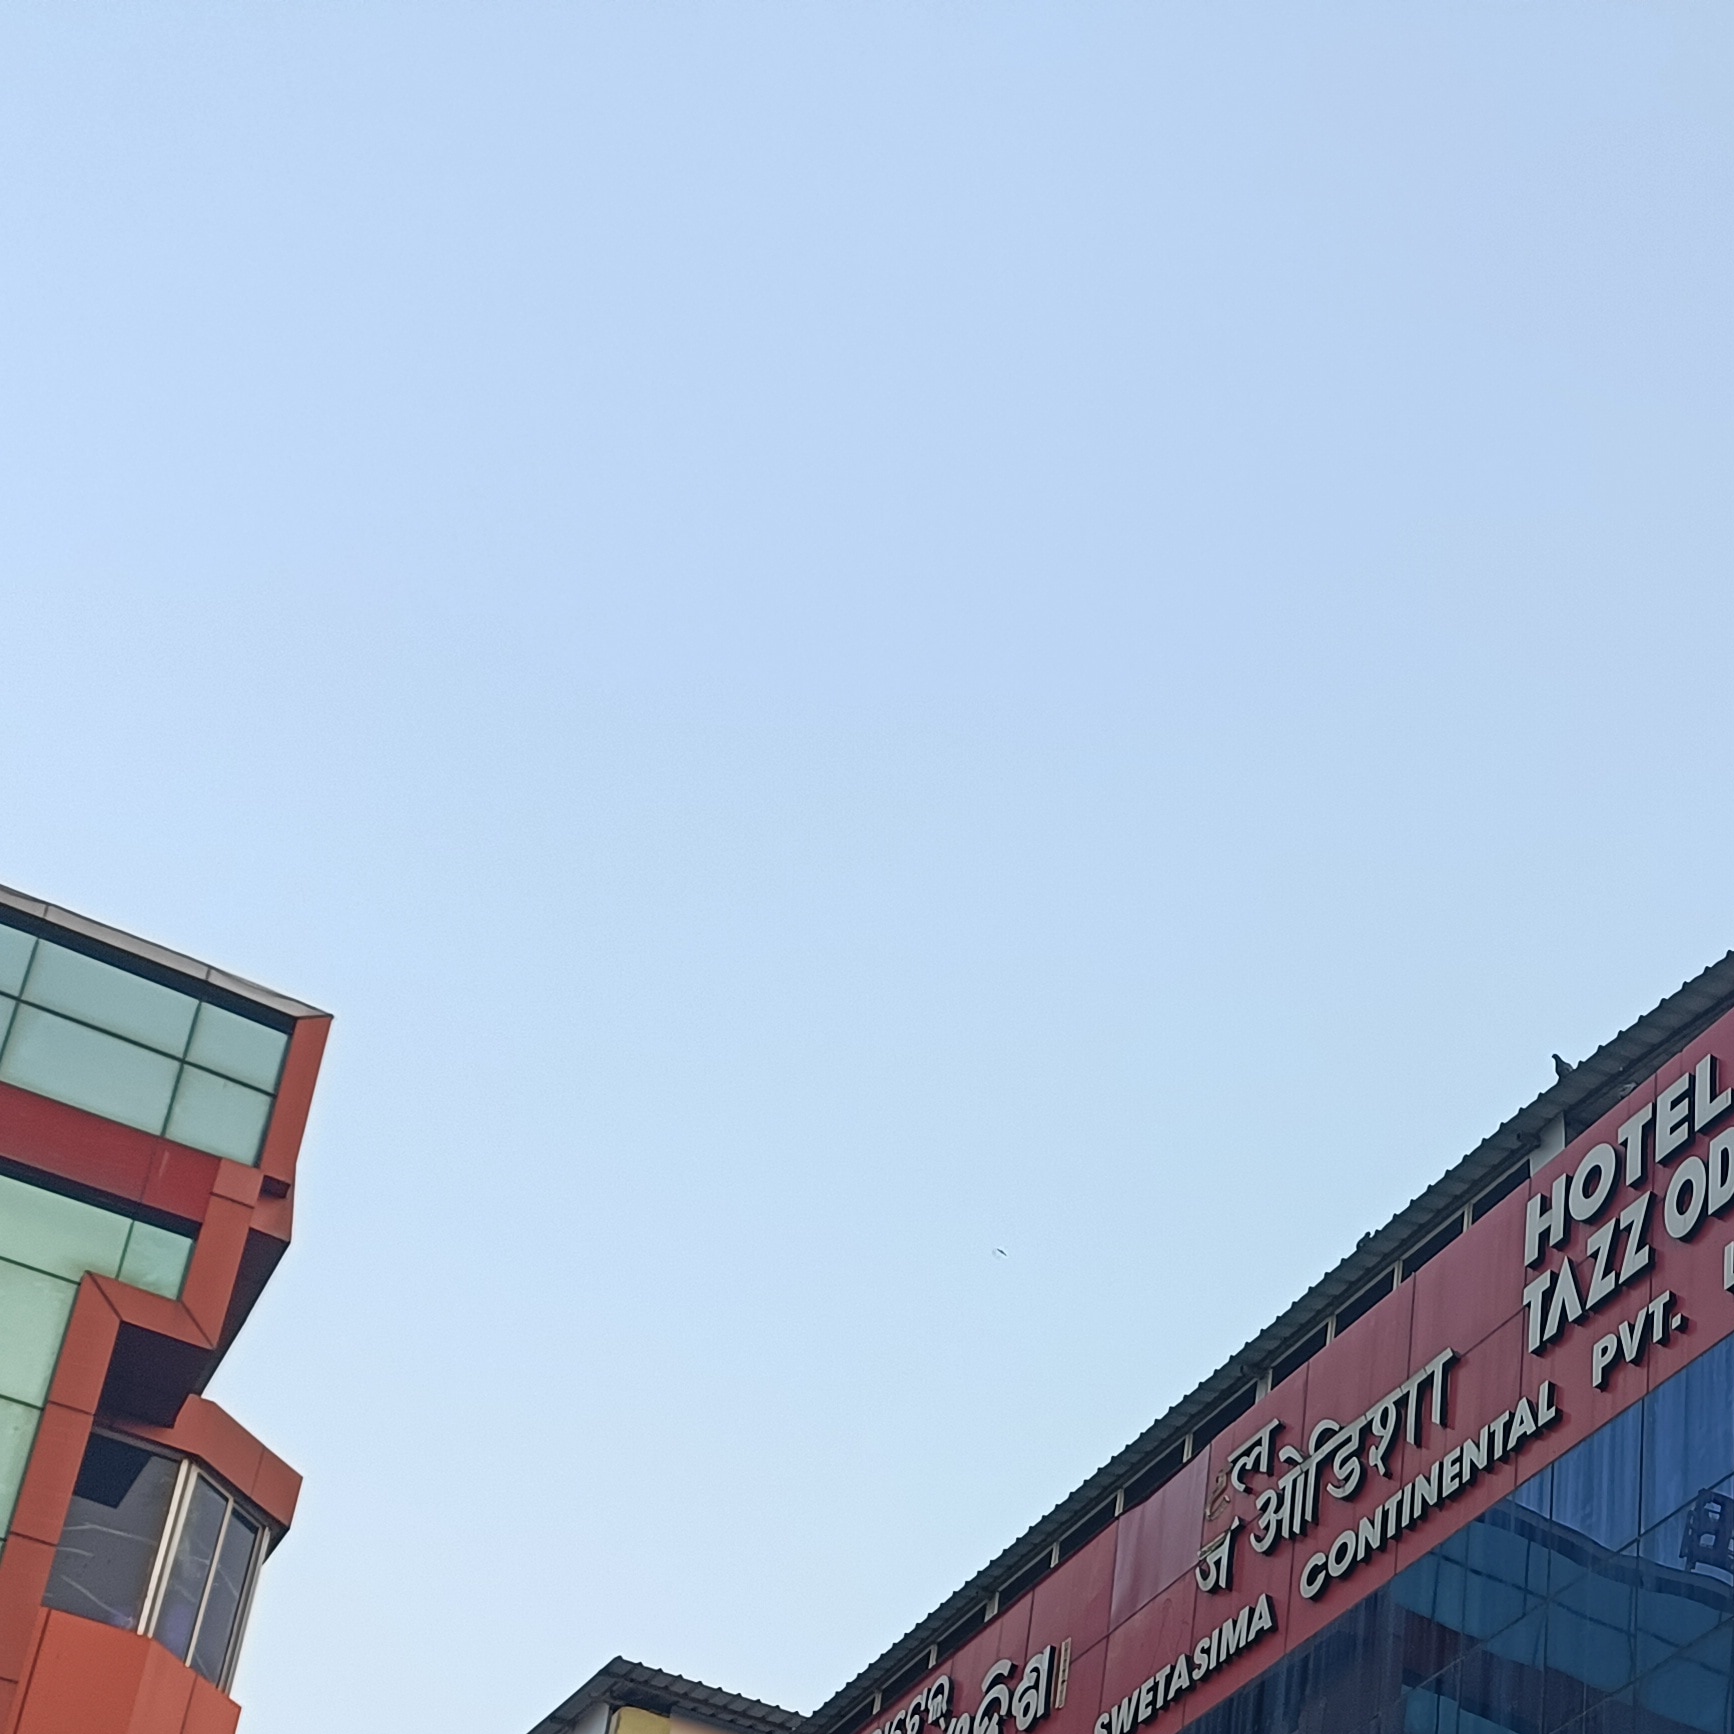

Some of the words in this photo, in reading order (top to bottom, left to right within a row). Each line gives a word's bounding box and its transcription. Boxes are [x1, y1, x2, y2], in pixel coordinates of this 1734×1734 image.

[1524, 1053, 1732, 1267] HOTEL
[1523, 1191, 1655, 1354] TAZZ
[1300, 1380, 1557, 1598] CONTINENTAL
[1592, 1290, 1685, 1387] PVT.
